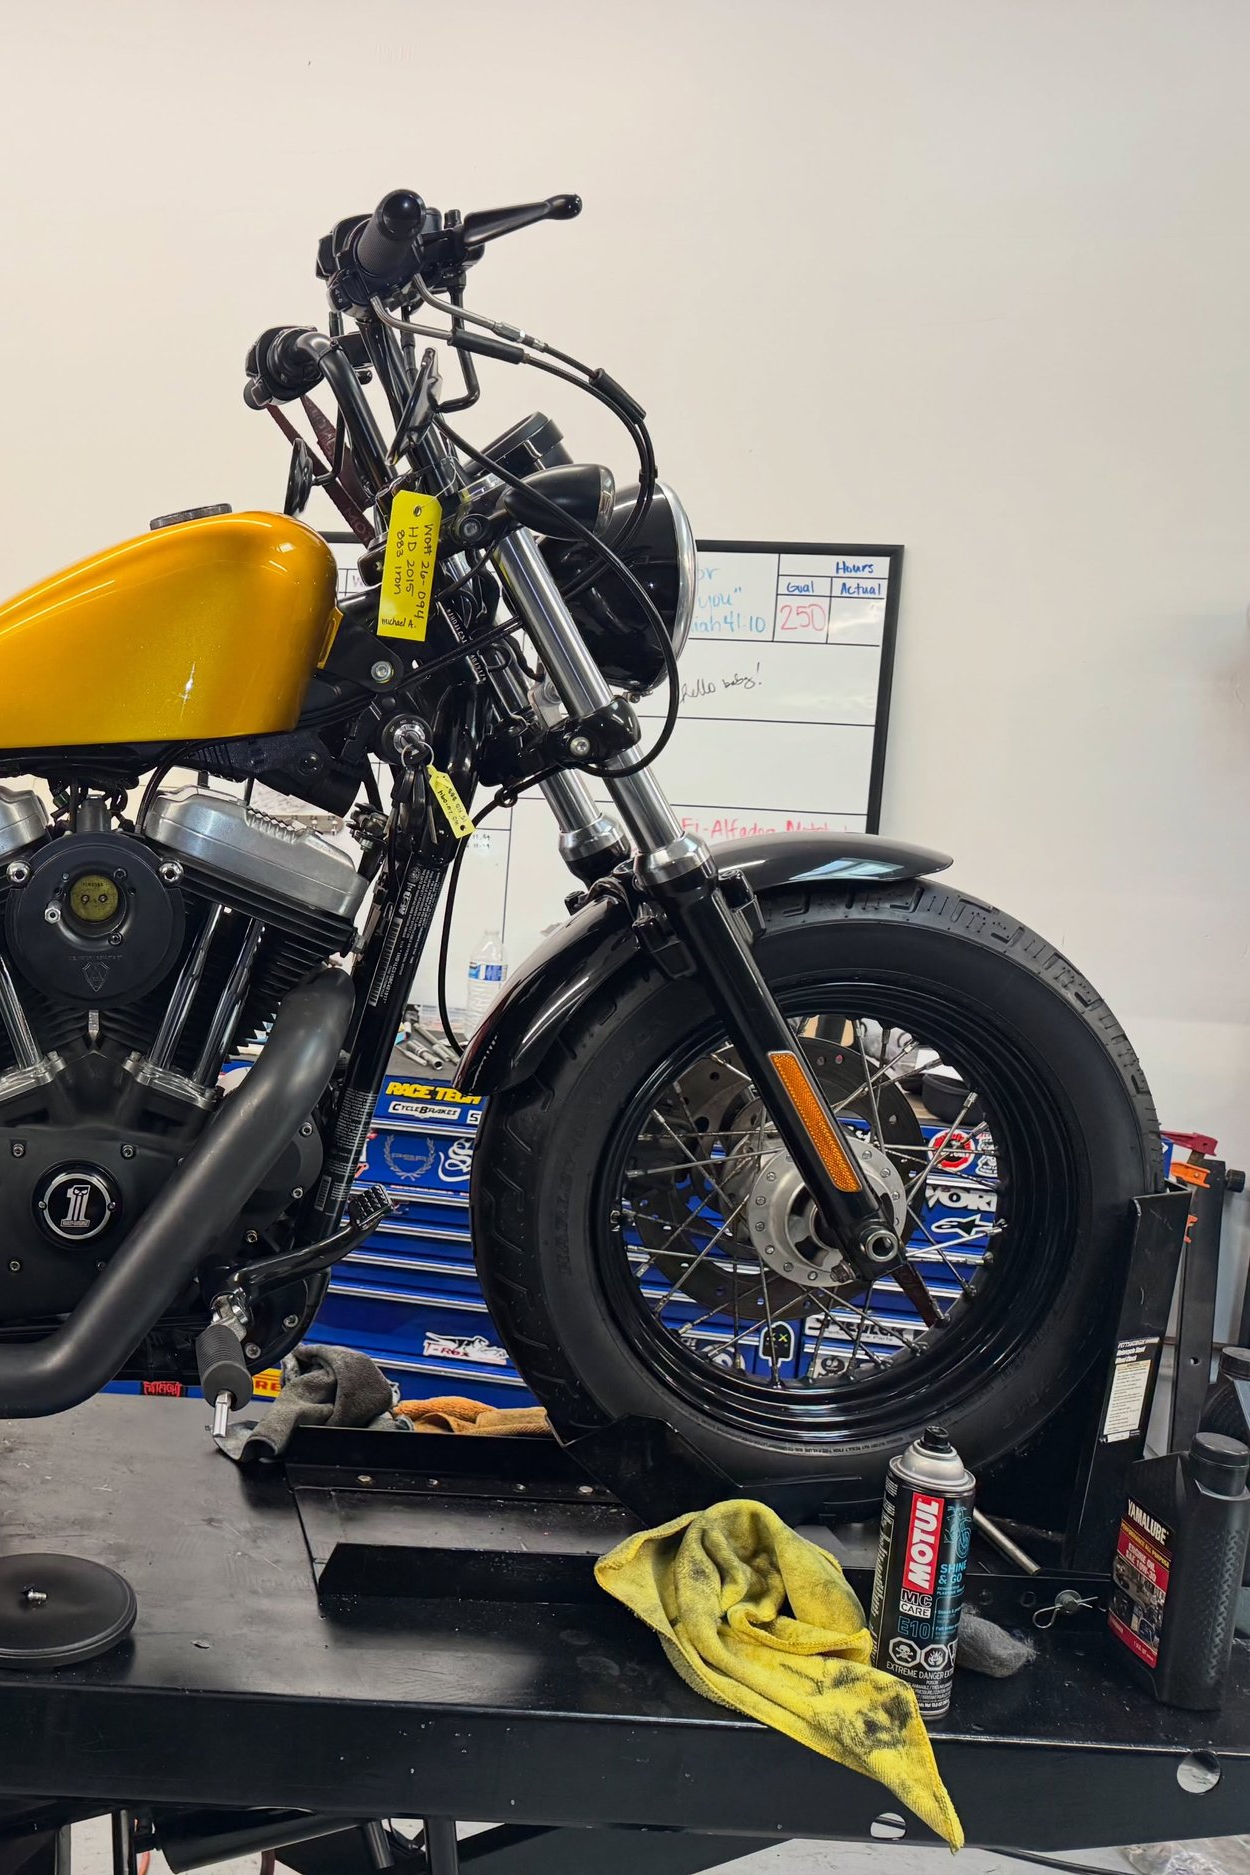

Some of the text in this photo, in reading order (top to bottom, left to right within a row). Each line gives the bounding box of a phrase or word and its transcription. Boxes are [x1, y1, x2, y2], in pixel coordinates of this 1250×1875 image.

[836, 561, 874, 574] Hours
[406, 560, 415, 597] 2015
[786, 581, 881, 596] Goal Actual
[780, 604, 826, 631] 250
[386, 1082, 434, 1099] RACE
[1128, 1498, 1167, 1546] YAMALUBE
[908, 1499, 939, 1590] MOTUL
[940, 1560, 967, 1574] SHINE
[951, 1573, 962, 1583] GO
[901, 1589, 933, 1608] MC
[900, 1603, 930, 1617] CARE
[898, 1616, 930, 1640] E10
[886, 1660, 917, 1679] EXTREME
[918, 1670, 944, 1680] DANGER
